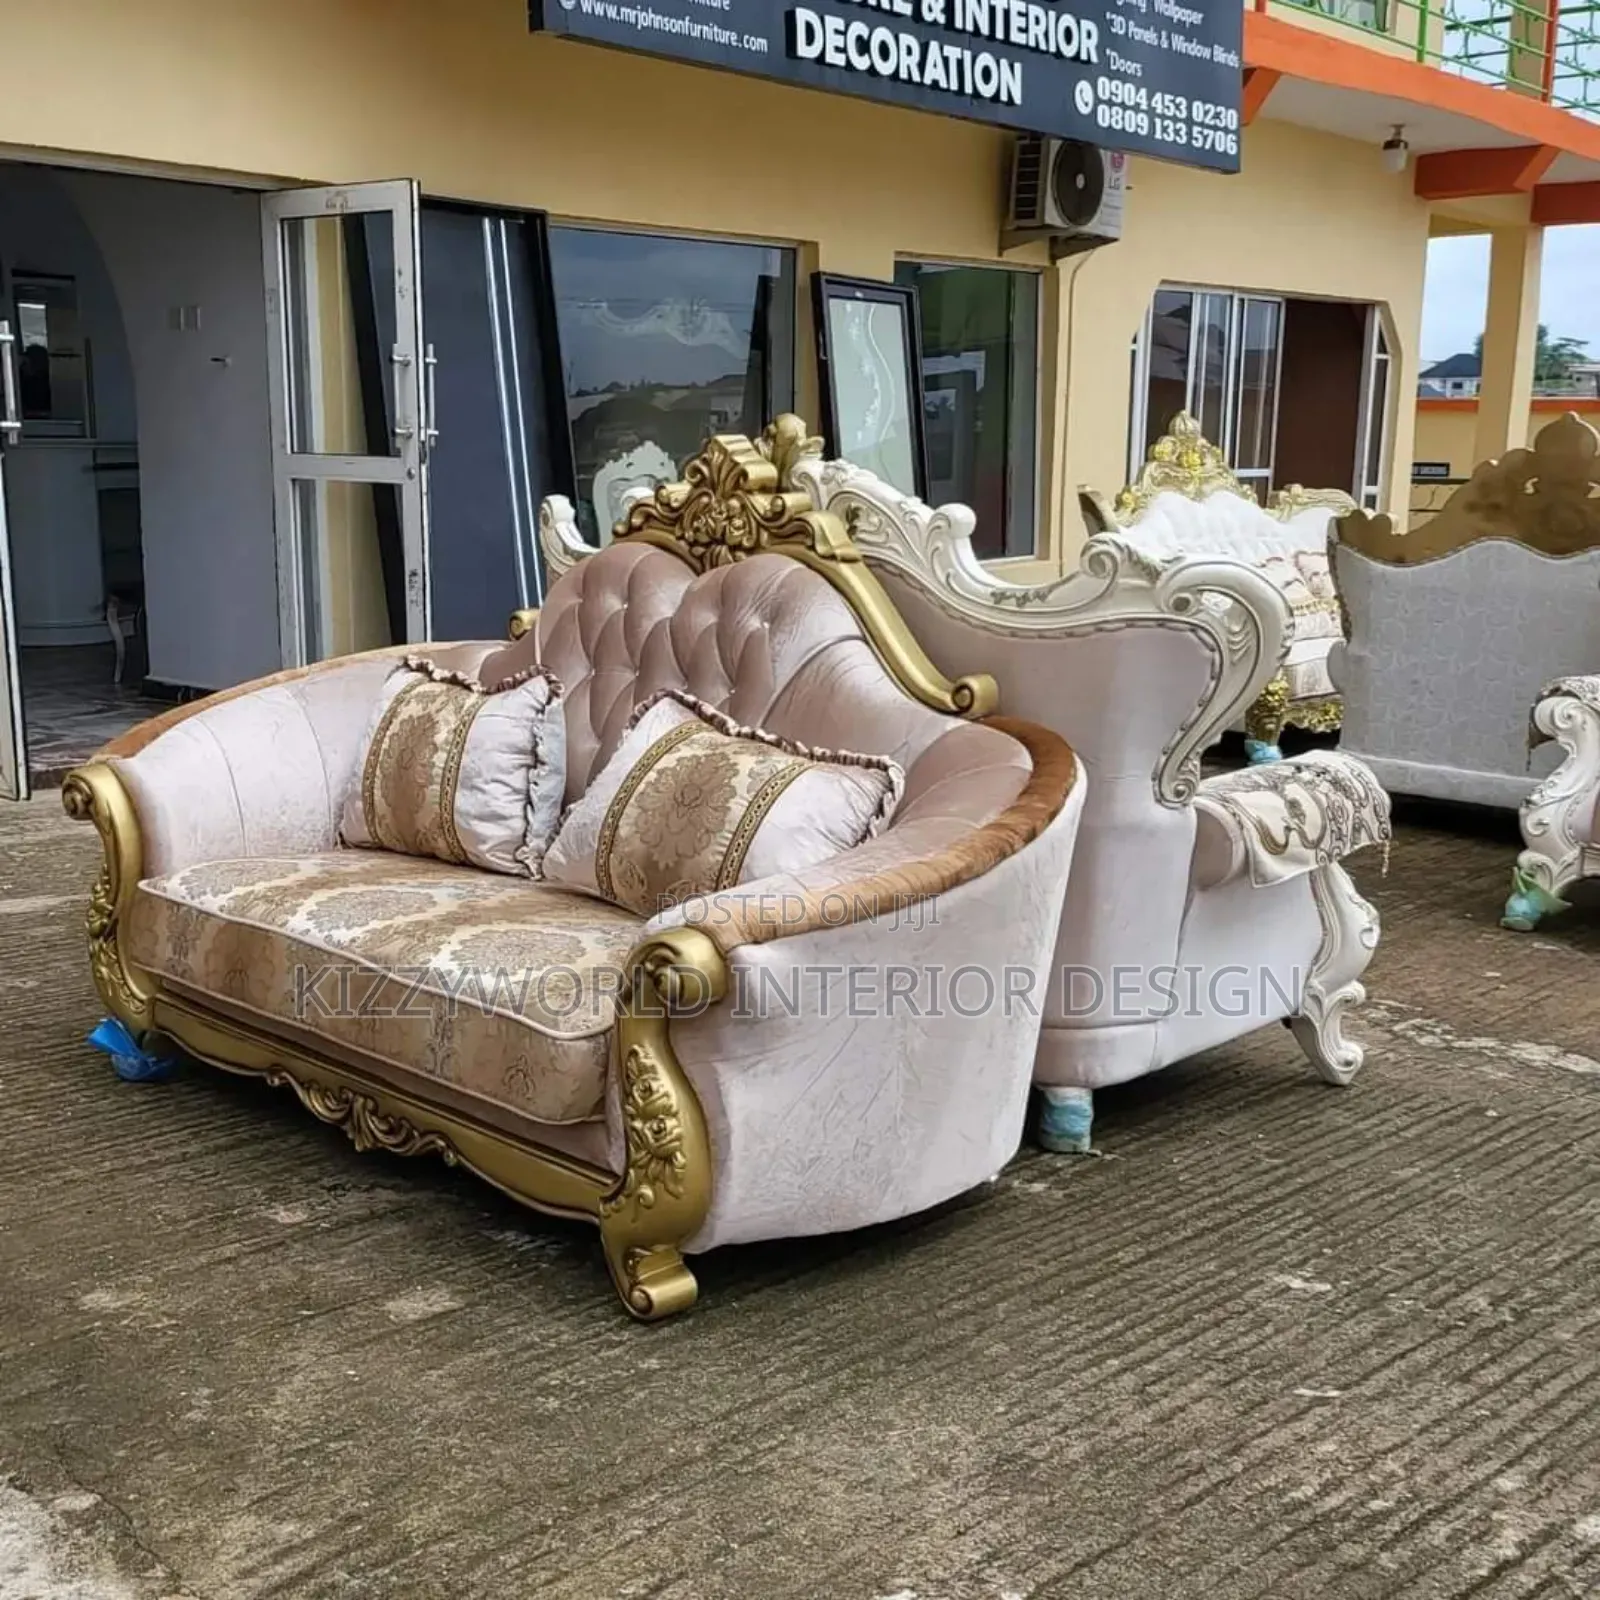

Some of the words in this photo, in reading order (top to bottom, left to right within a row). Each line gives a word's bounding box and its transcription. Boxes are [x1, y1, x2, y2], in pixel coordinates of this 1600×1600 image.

[580, 0, 769, 52] www.mrjohnsonfurniture.com
[954, 0, 1099, 63] INTERIOR
[1128, 20, 1159, 46] Panels
[1160, 30, 1169, 48] &
[1171, 32, 1212, 60] Window
[1213, 44, 1239, 68] Blinds
[795, 7, 1022, 105] DECORATION
[1097, 76, 1148, 110] 0904
[1151, 91, 1188, 119] 453
[1192, 100, 1238, 130] 0230
[1097, 104, 1149, 136] 0809
[1153, 118, 1187, 144] 133
[1191, 126, 1237, 155] 5706
